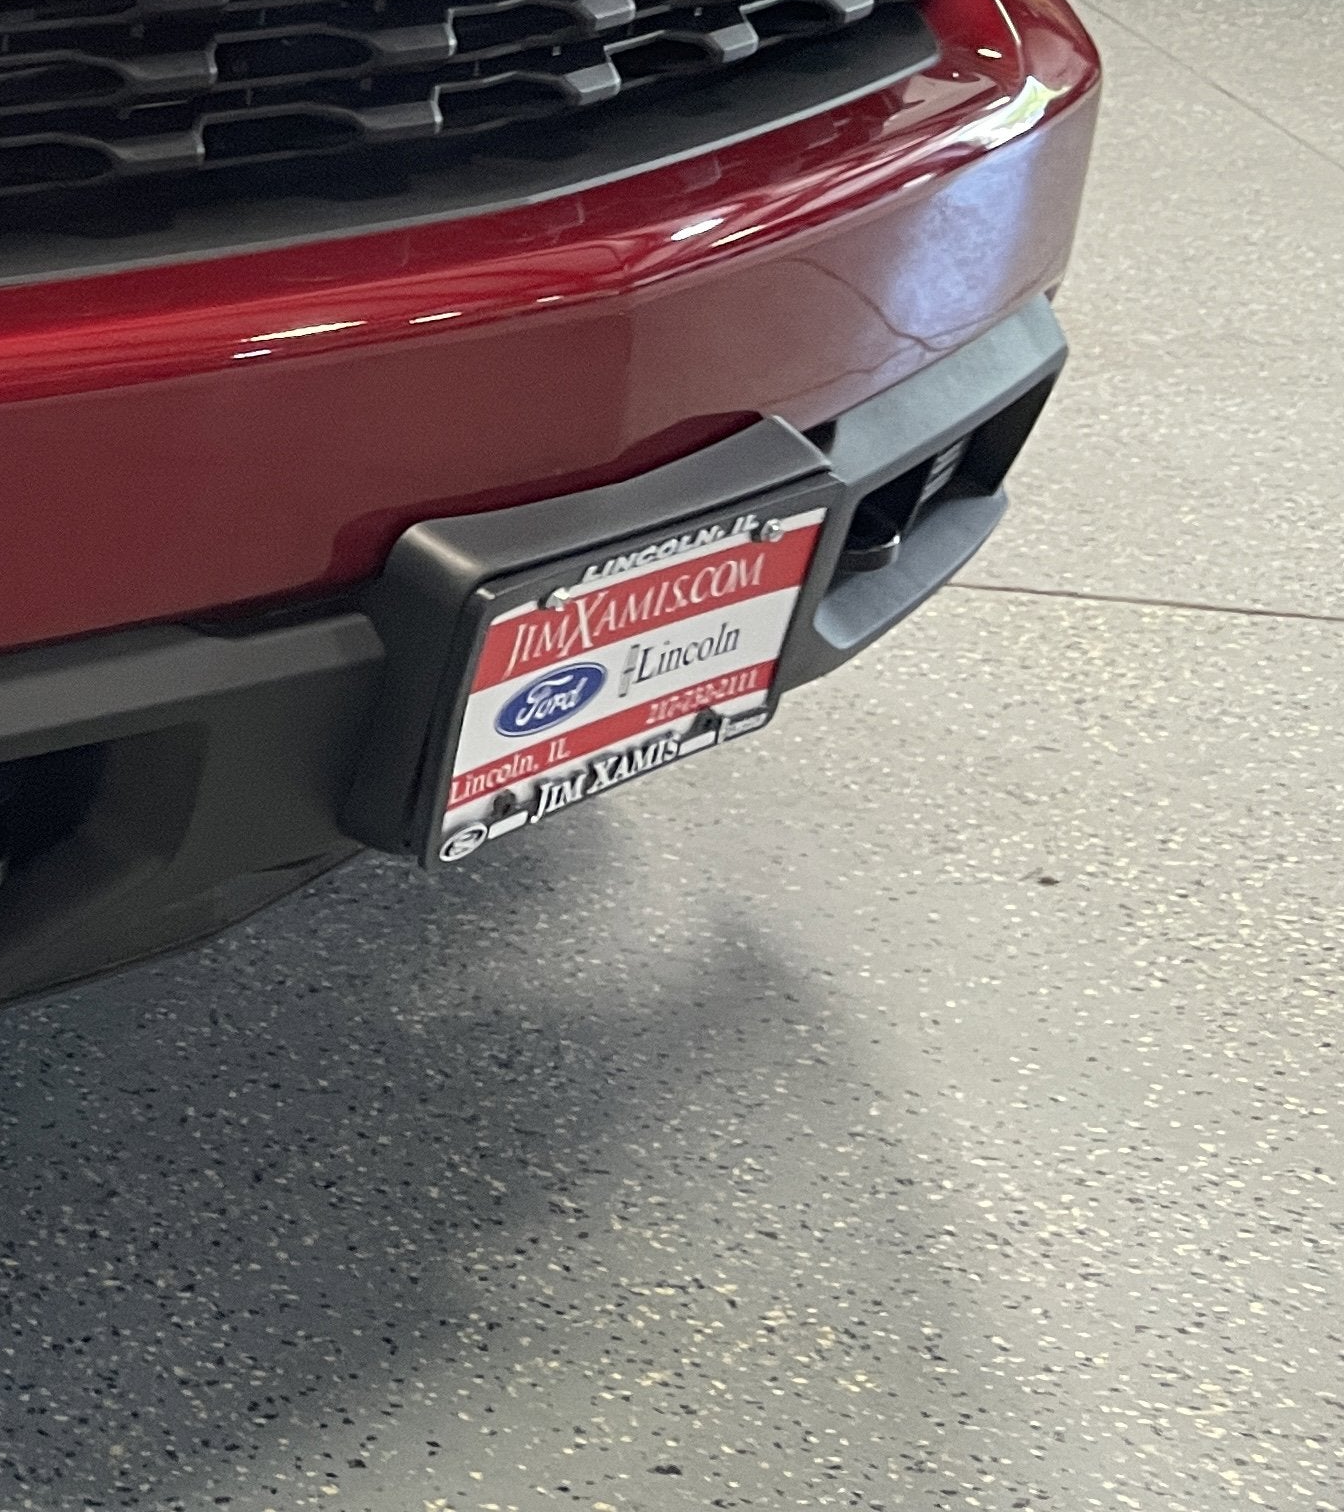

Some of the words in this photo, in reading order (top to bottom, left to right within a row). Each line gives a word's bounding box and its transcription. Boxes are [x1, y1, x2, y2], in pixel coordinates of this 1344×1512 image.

[630, 621, 741, 684] Lincoln
[514, 674, 589, 727] Ford
[530, 773, 588, 824] JIM
[587, 733, 682, 794] XAMIS
[547, 737, 572, 765] IL
